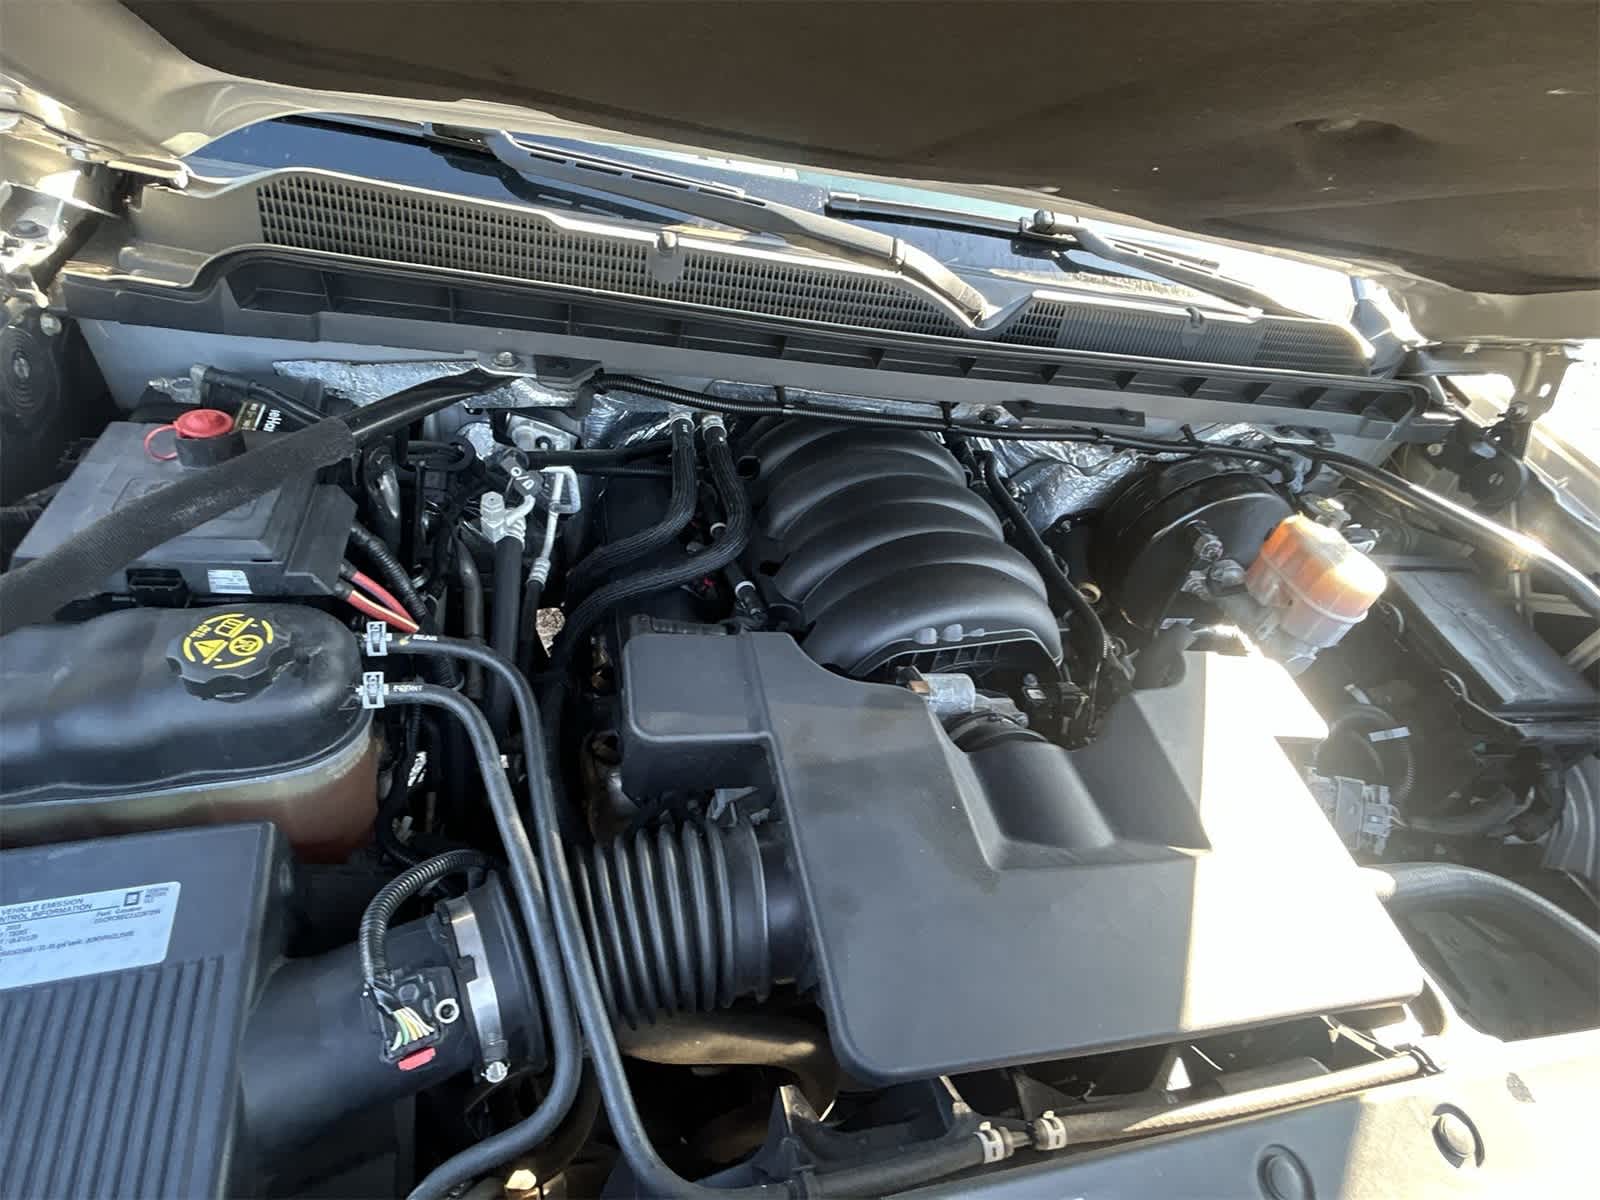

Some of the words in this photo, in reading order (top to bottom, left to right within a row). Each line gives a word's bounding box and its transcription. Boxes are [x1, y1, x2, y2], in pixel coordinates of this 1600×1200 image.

[0, 912, 29, 921] NTROL
[31, 904, 93, 917] INFORMATION
[1, 904, 39, 916] VEHICLE
[41, 898, 84, 910] EMISSION
